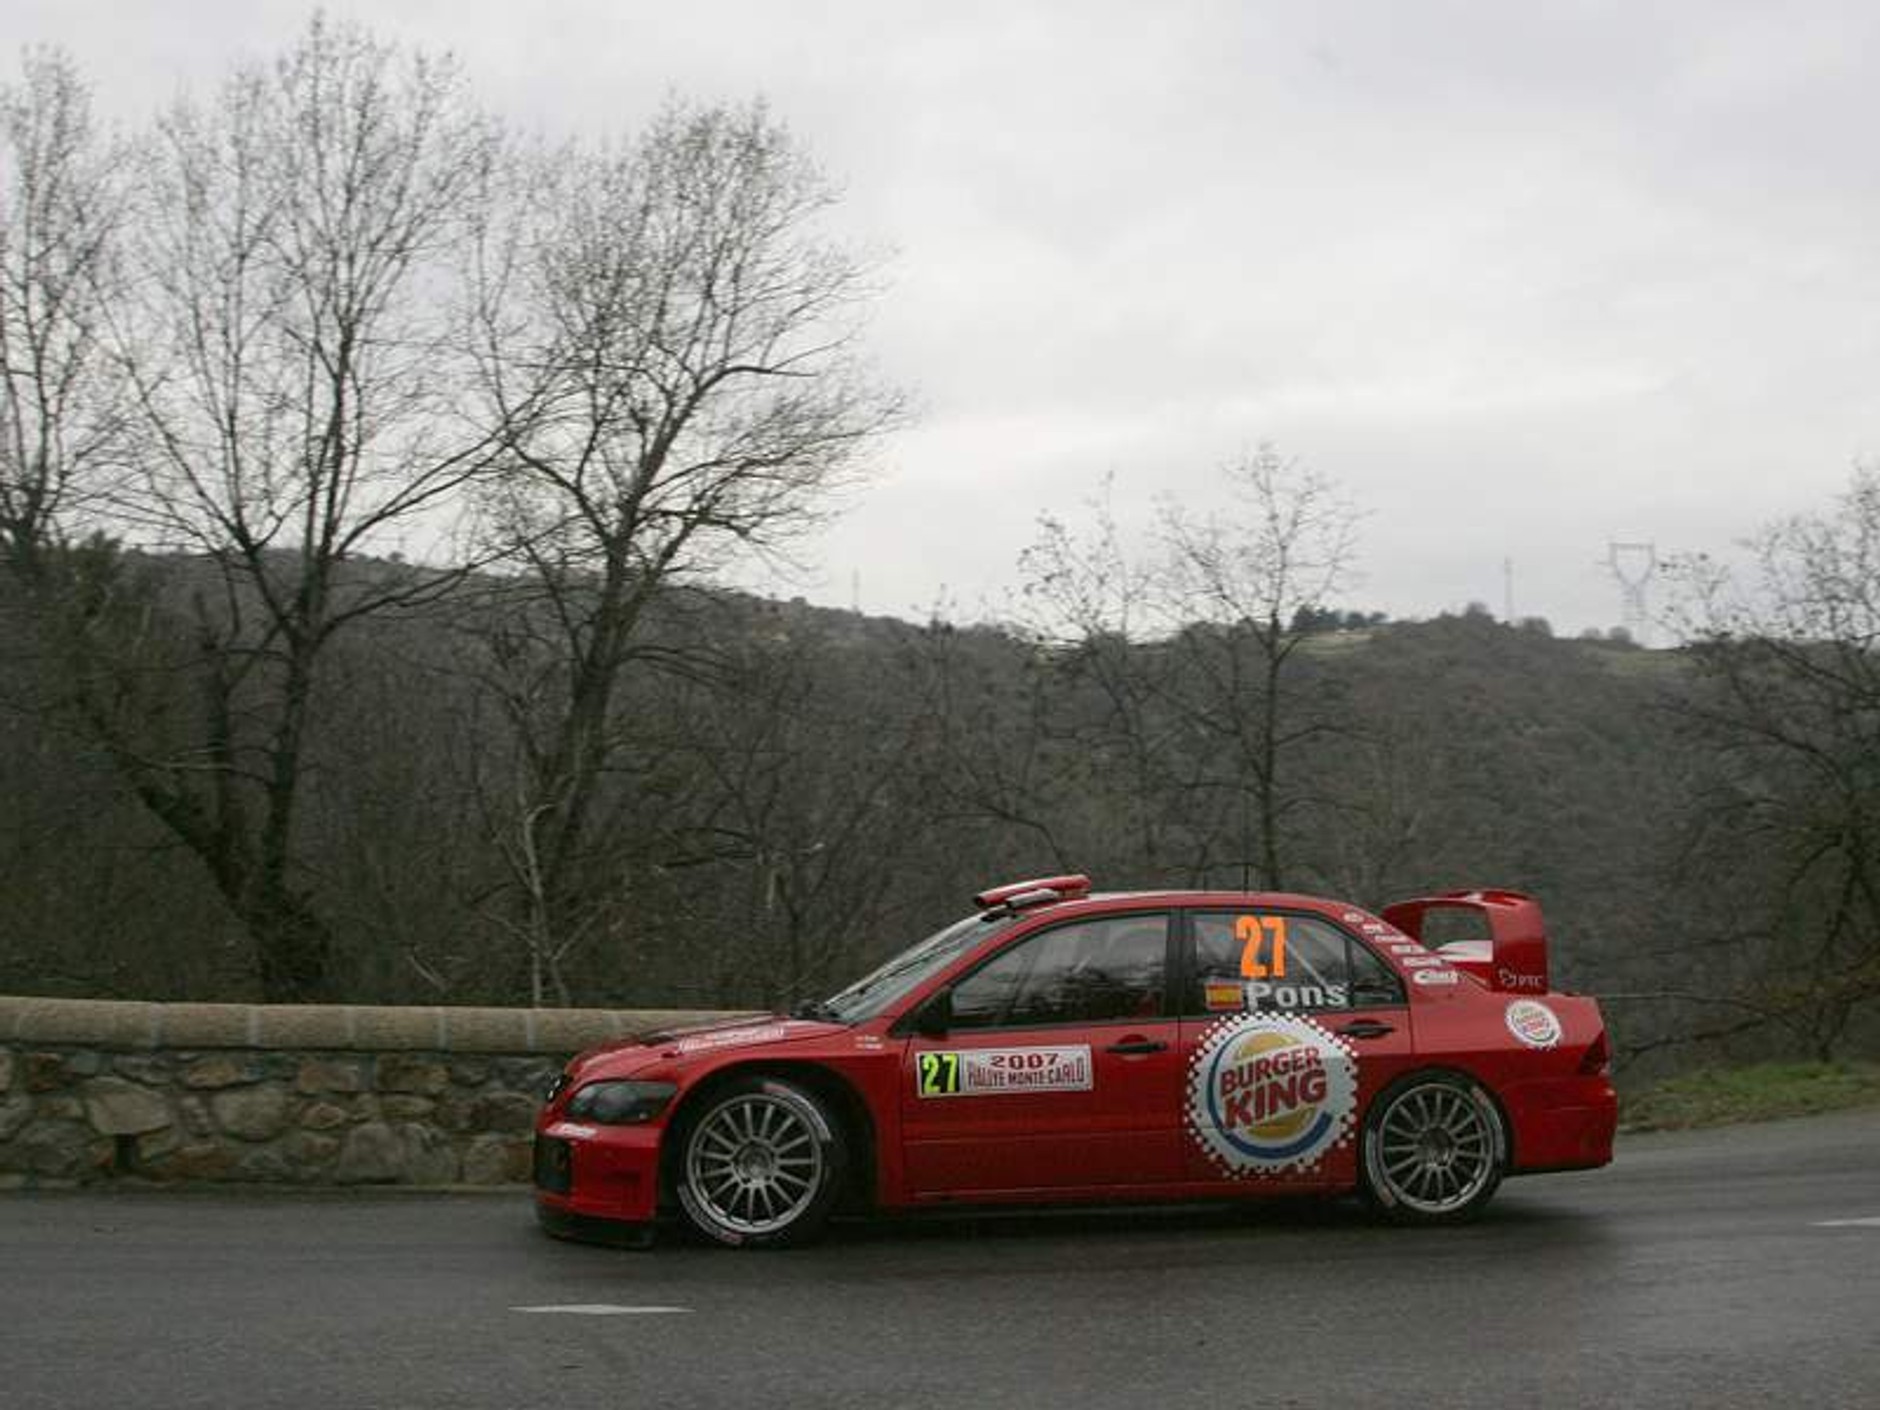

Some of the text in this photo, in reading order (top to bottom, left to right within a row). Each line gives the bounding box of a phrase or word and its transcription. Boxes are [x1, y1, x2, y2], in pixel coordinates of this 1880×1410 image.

[1235, 914, 1288, 980] 27
[1246, 980, 1349, 1011] Pons
[921, 1051, 961, 1093] 27
[990, 1052, 1060, 1070] 2007
[1220, 1046, 1322, 1096] BURGER
[1223, 1069, 1328, 1130] KING
